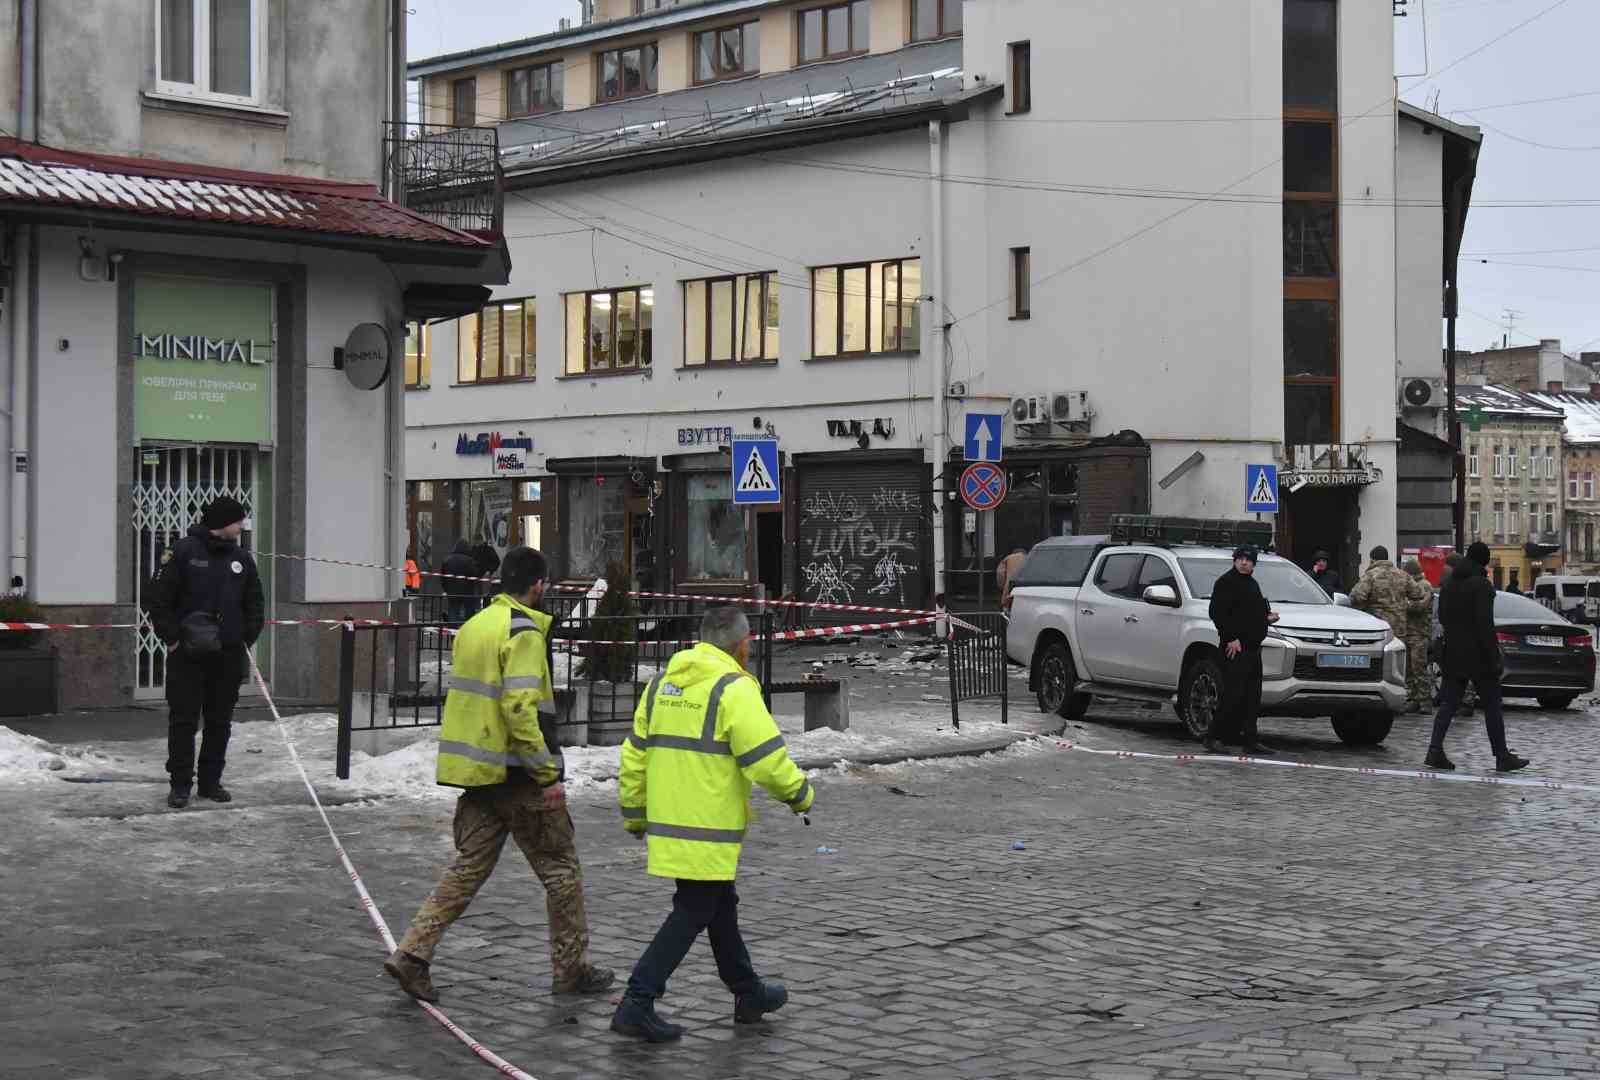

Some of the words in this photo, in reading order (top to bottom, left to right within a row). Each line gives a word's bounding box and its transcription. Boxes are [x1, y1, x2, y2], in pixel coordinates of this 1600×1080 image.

[142, 334, 265, 363] MINIMAL
[199, 379, 257, 392] ПРИКРАСИ
[173, 391, 198, 401] ДЛЯ
[200, 391, 225, 402] ТЕБЕ
[678, 427, 732, 445] ВЗУТТЯ
